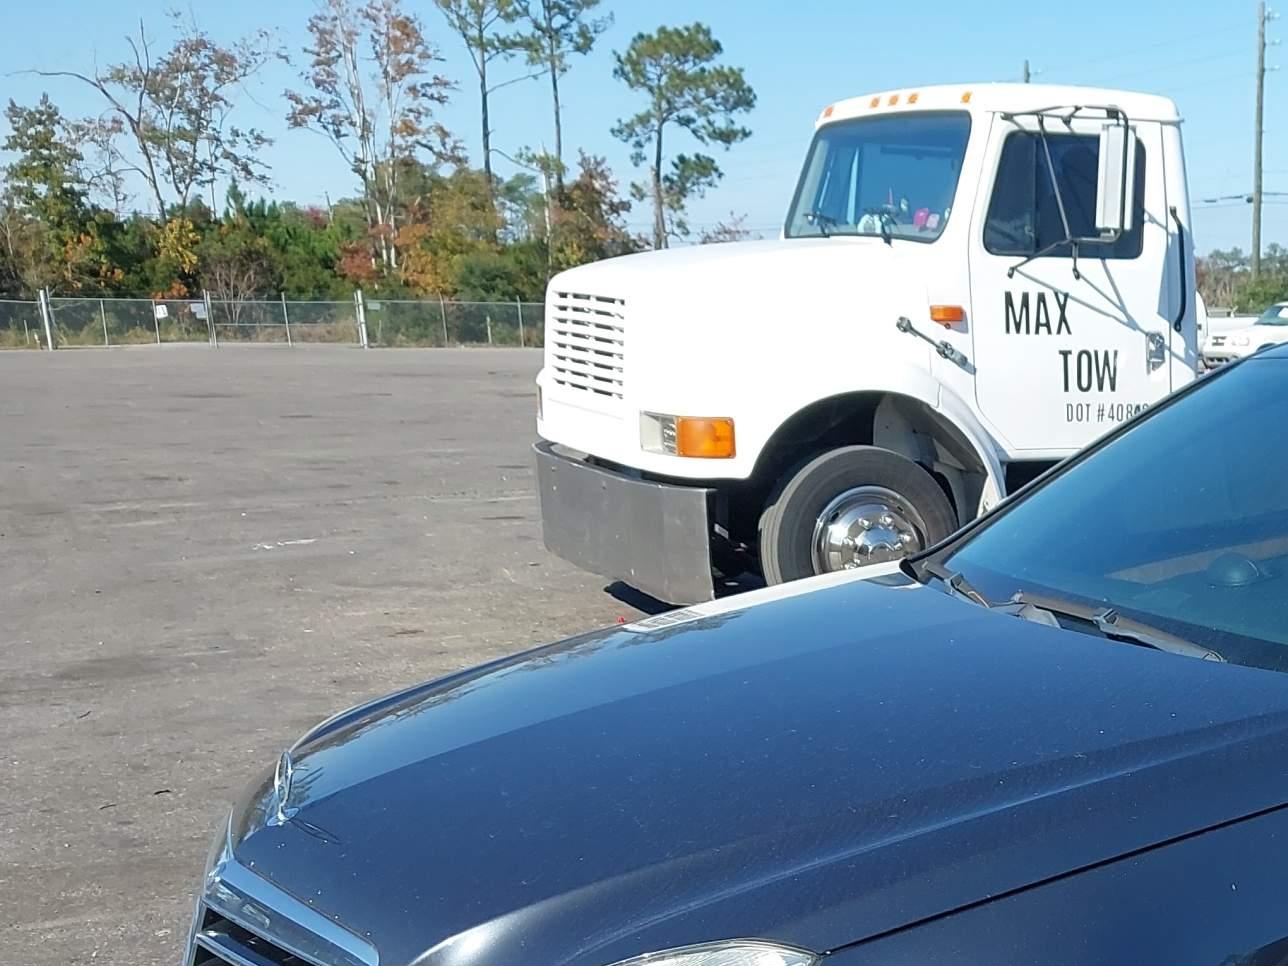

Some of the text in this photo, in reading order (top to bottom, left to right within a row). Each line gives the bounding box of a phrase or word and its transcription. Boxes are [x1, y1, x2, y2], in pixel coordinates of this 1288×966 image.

[1004, 291, 1072, 335] MAX
[1059, 349, 1118, 393] TOW
[1066, 403, 1091, 422] DOT
